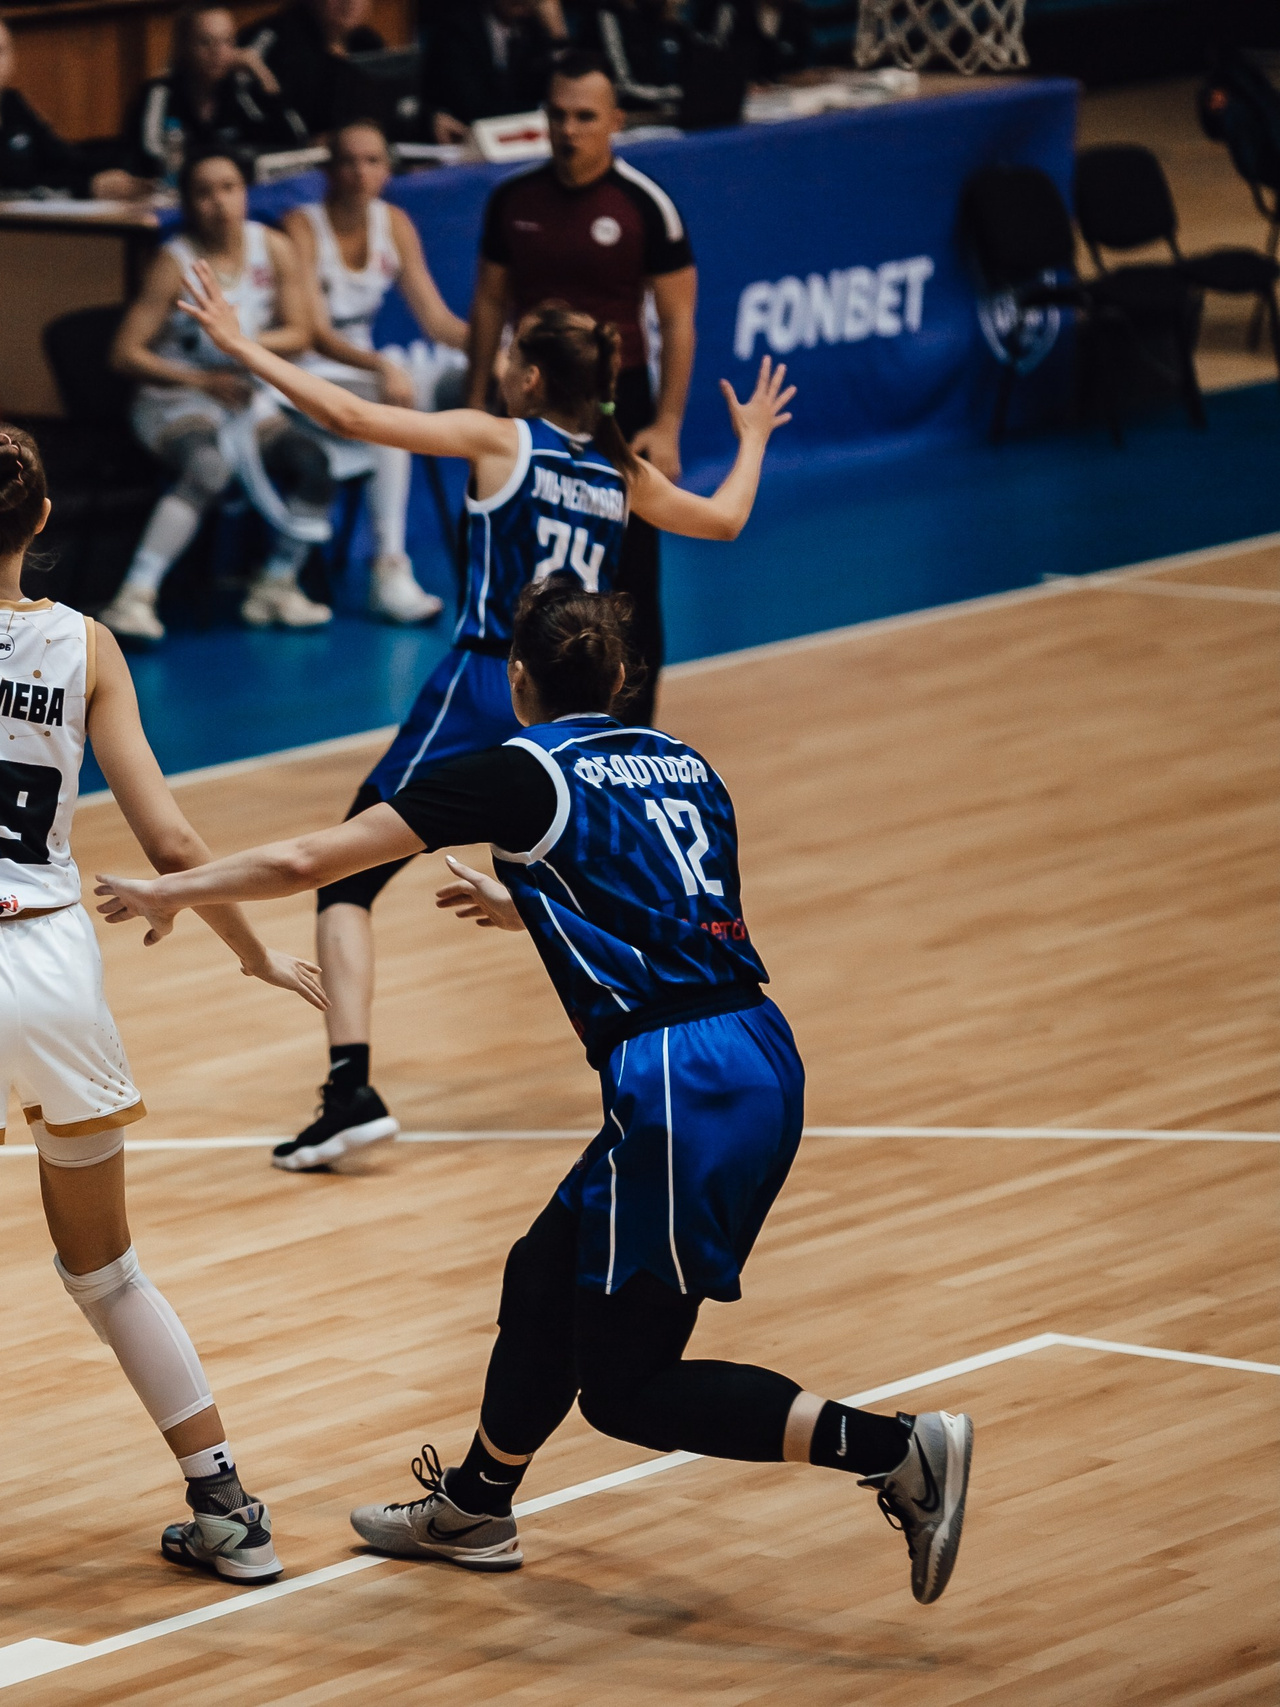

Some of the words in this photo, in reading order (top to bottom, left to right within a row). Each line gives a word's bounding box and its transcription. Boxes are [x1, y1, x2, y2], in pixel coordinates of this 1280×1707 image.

[734, 255, 934, 361] FONBET
[573, 754, 709, 789] ФЕДОТОВА
[643, 797, 725, 897] 12
